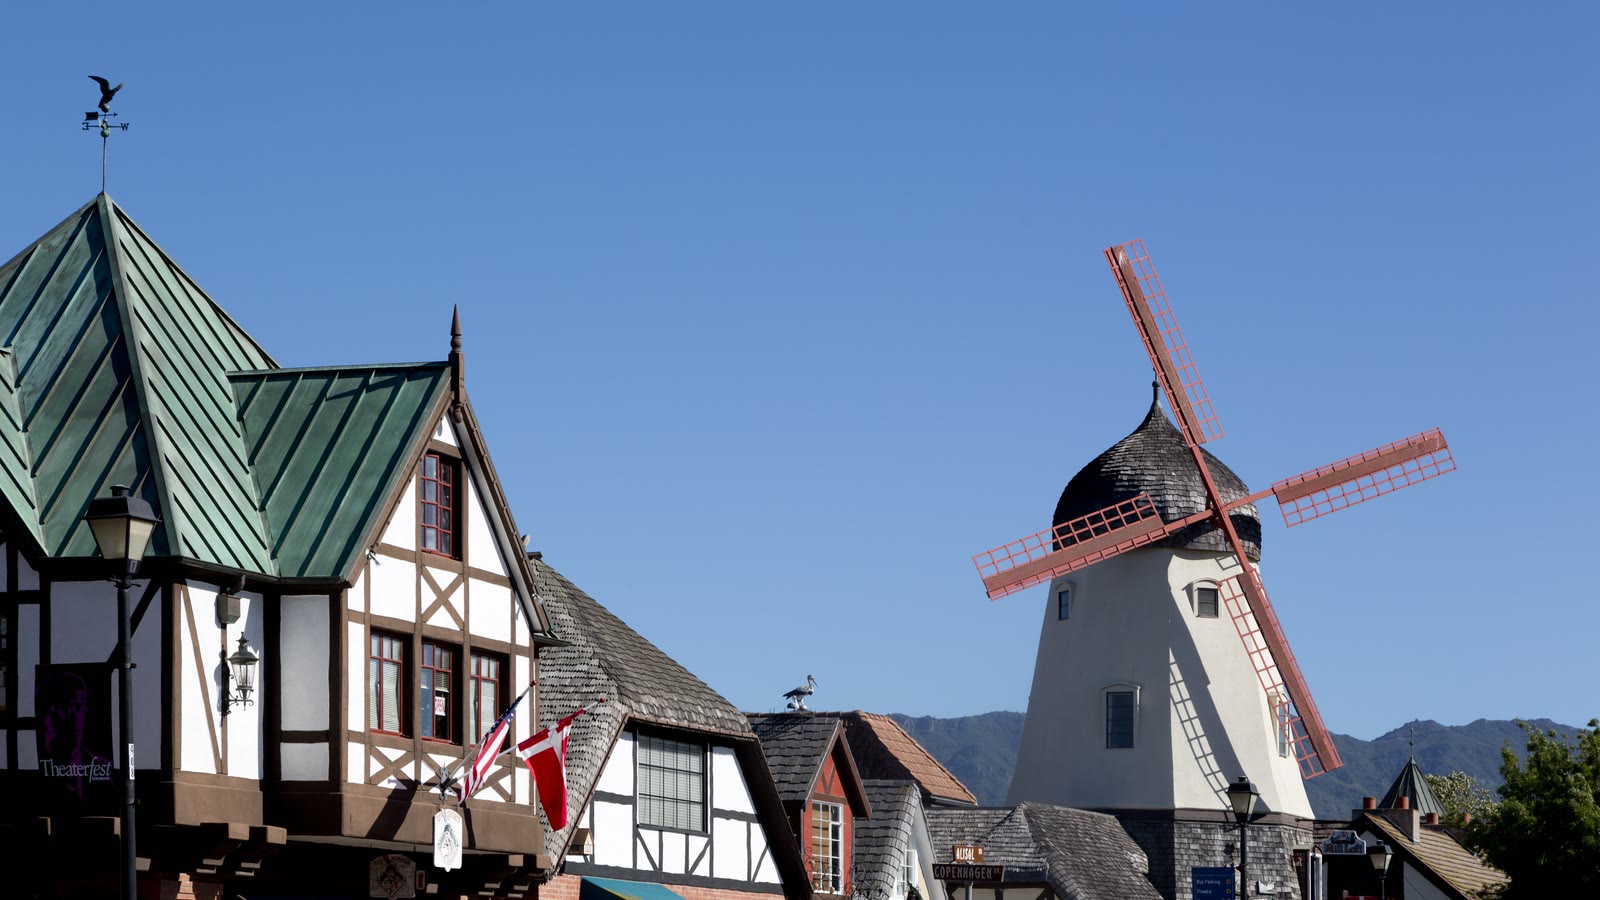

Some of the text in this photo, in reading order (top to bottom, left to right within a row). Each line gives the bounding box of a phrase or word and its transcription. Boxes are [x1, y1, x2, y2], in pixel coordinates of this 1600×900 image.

[39, 756, 112, 783] Theaterfest
[956, 847, 975, 860] ALISAL
[934, 866, 992, 879] COPENHAGEN
